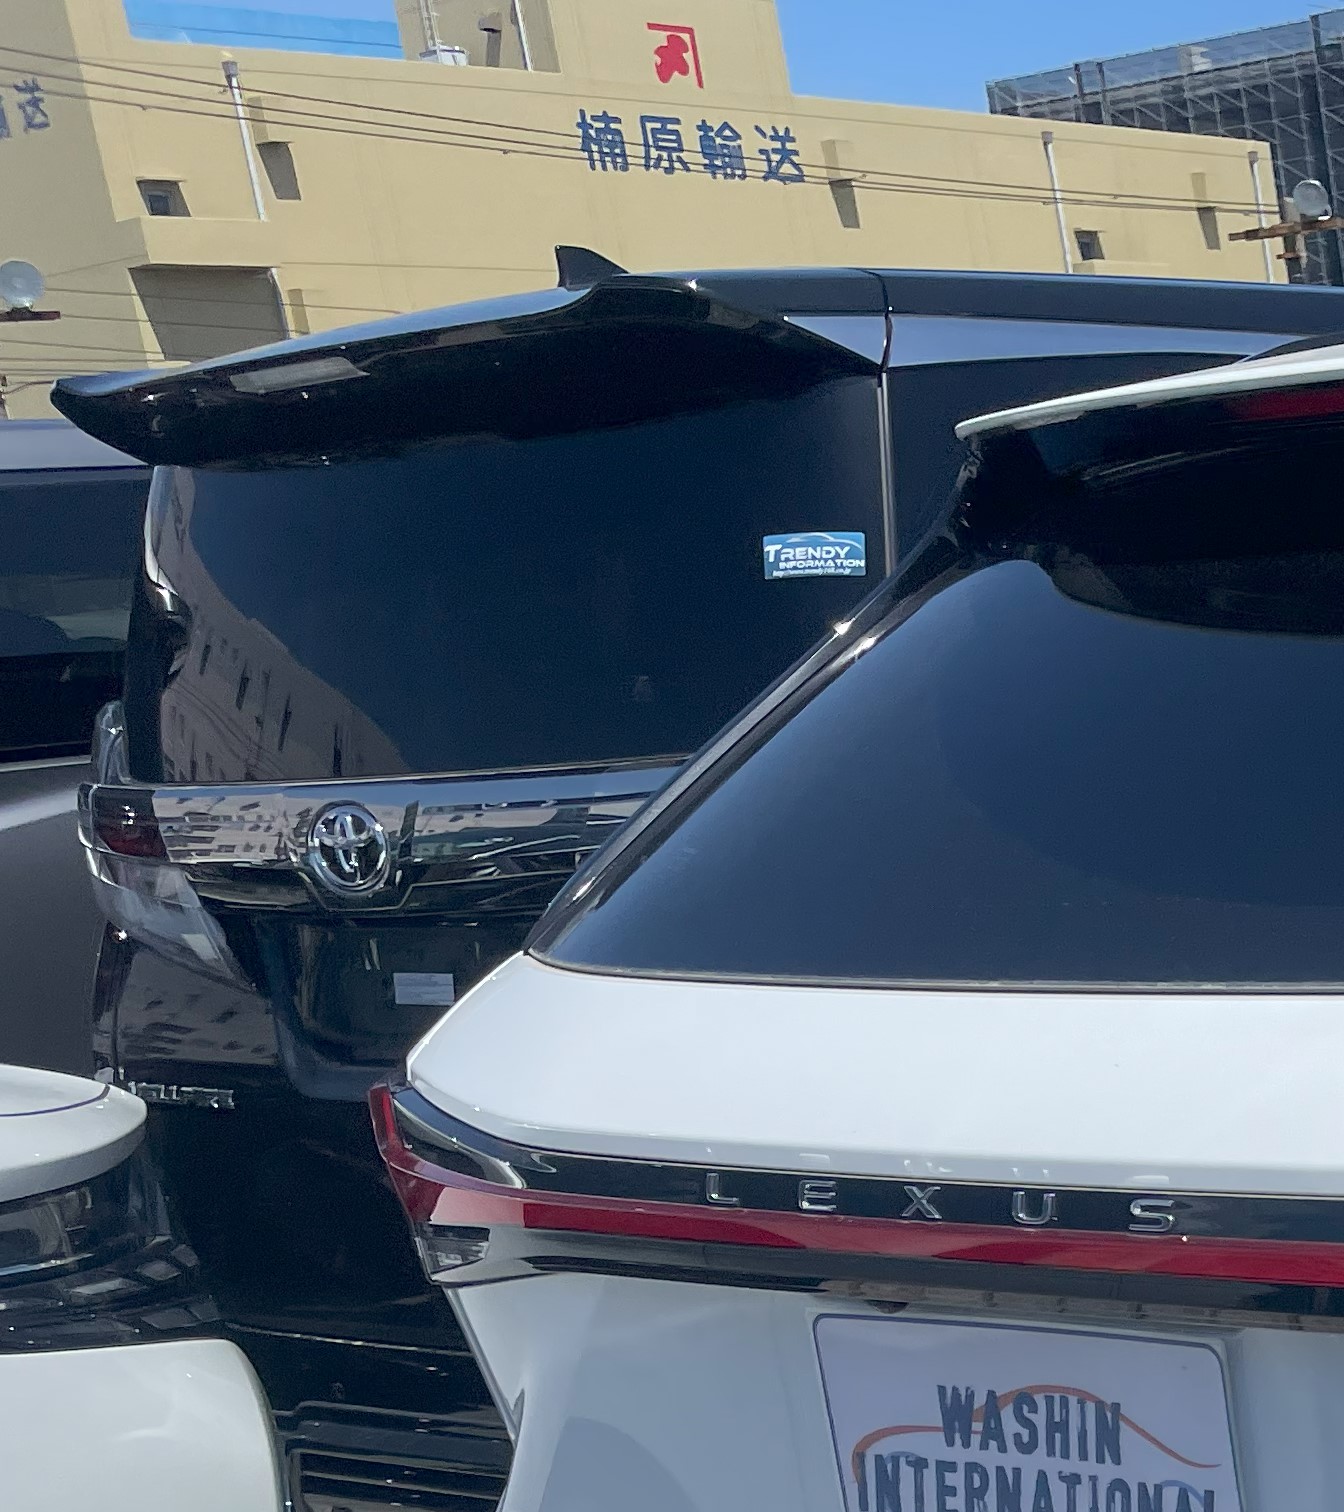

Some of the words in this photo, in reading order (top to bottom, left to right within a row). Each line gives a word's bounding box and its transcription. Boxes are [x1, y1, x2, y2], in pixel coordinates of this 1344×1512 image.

[576, 108, 805, 185] 楠原輸送
[764, 544, 850, 562] TRENDY
[779, 559, 865, 569] INFORMATION
[705, 1172, 1177, 1232] LEXUS
[937, 1384, 1122, 1465] WASHIN
